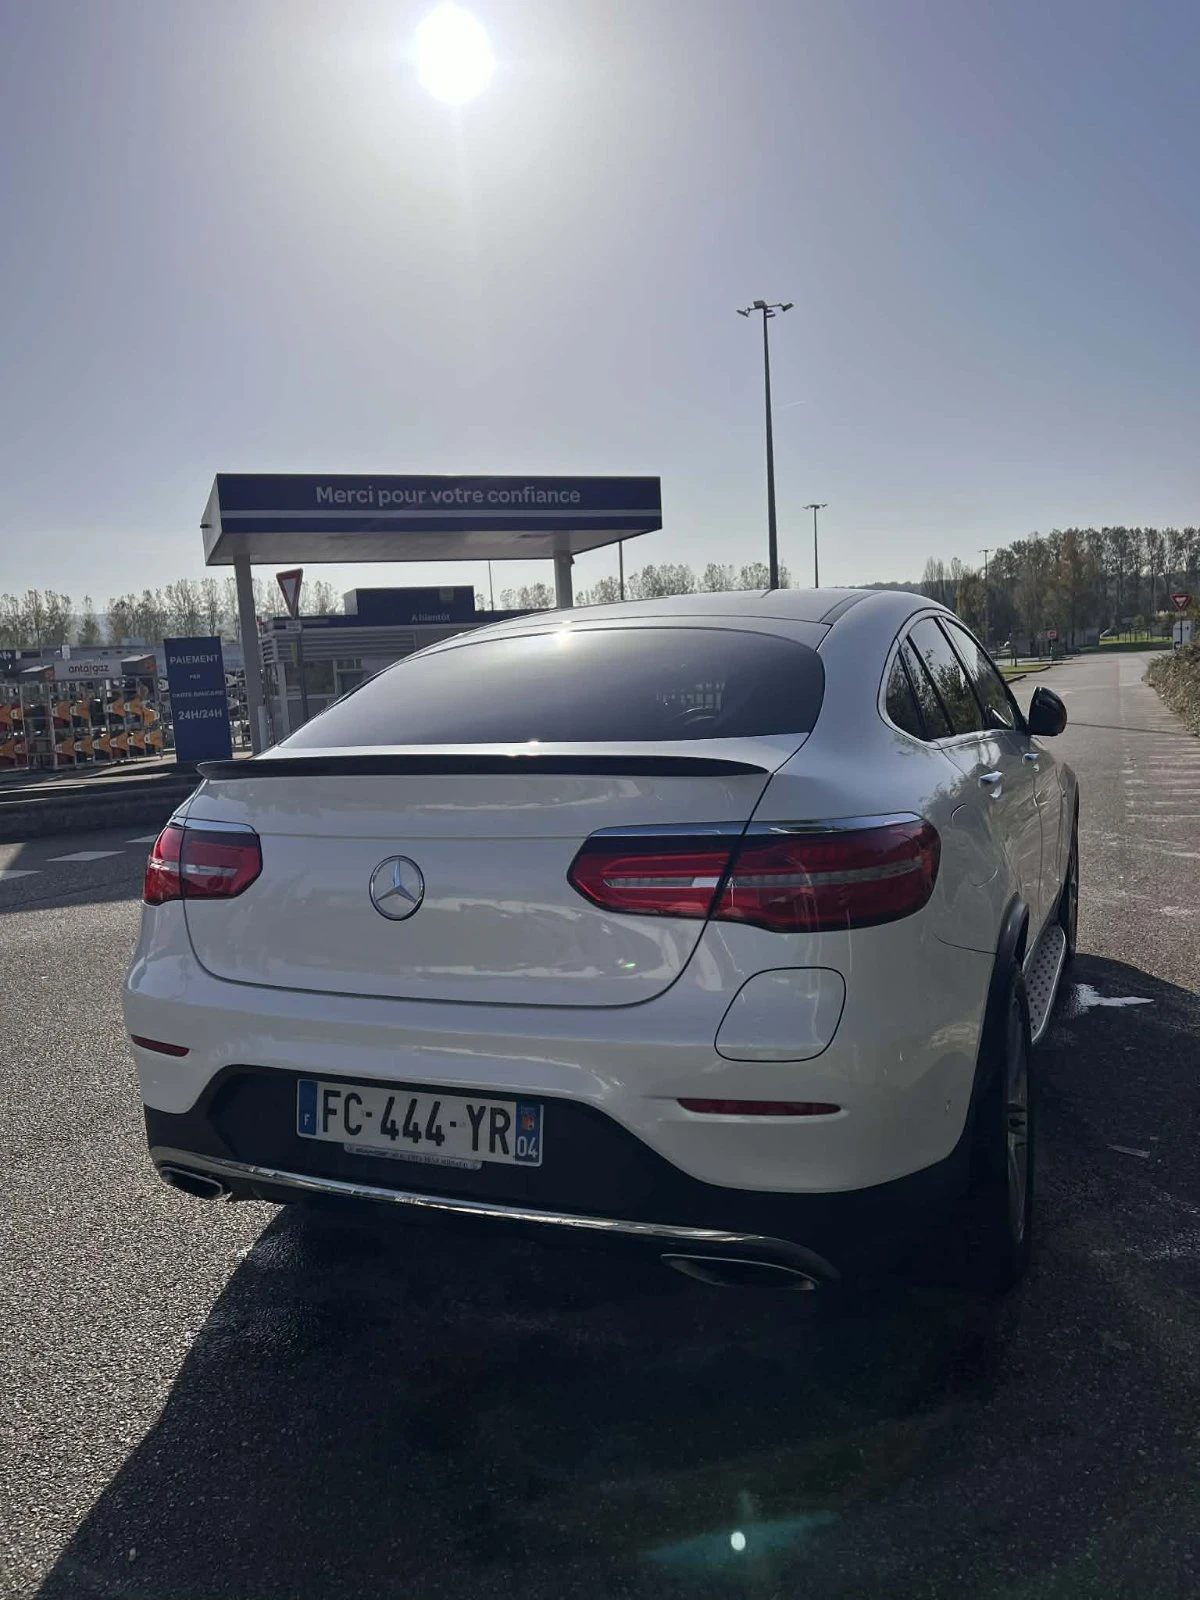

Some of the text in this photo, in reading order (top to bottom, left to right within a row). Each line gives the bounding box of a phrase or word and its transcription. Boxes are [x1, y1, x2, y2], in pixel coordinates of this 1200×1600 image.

[316, 486, 581, 507] Merci pour votre confiance
[169, 654, 219, 664] PAIEMENT
[178, 708, 223, 720] 24H/24H
[303, 1113, 310, 1126] F
[517, 1136, 538, 1158] 04
